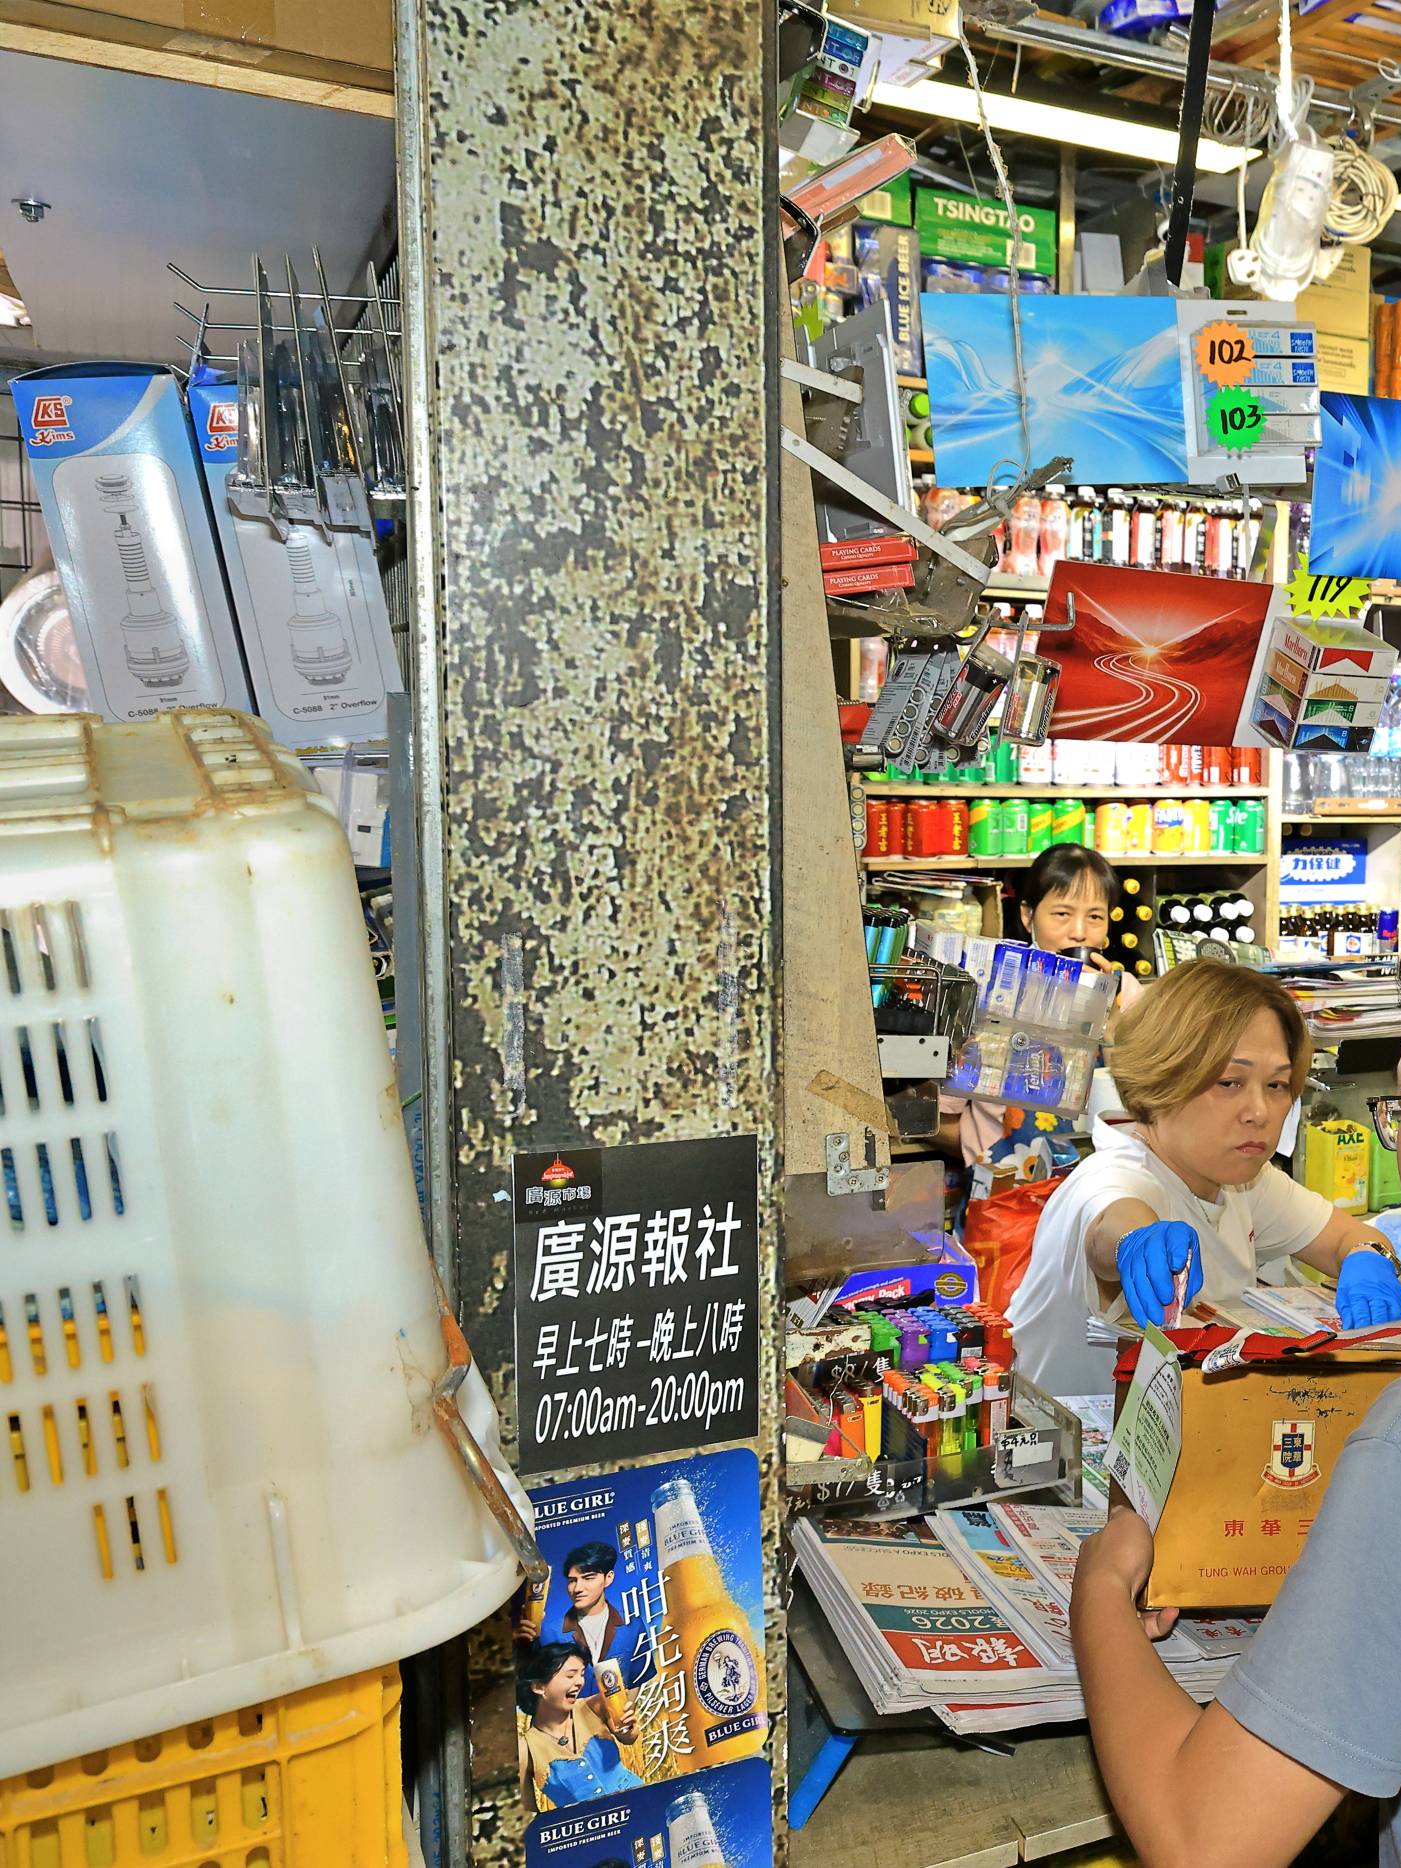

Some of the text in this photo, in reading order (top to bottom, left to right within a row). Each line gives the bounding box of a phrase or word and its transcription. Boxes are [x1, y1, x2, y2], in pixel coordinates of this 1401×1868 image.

[934, 197, 1035, 234] TSINGTAO
[897, 234, 911, 273] BEER
[898, 277, 911, 299] ICE
[897, 304, 911, 342] BLUE
[1209, 339, 1251, 365] 102
[1221, 405, 1261, 435] 103
[30, 429, 75, 446] Kims
[206, 436, 238, 451] Kim
[832, 544, 882, 557] PLAYING CARDS
[830, 573, 879, 585] PLAYING CARDS
[1308, 575, 1353, 602] 119
[1284, 632, 1308, 661] Marlboro
[293, 704, 323, 714] C-5088
[341, 698, 378, 709] Overflow
[1292, 857, 1341, 870] 力保健
[1336, 1132, 1365, 1146] AXE
[525, 1186, 592, 1207] 廣源市場
[530, 1201, 742, 1303] 廣源報社
[879, 1285, 906, 1300] Pack
[535, 1370, 745, 1444] 07:00am-20:00pm
[534, 1492, 614, 1519] LUE GIRL
[562, 1515, 590, 1526] PREMIUM
[591, 1512, 606, 1520] BEER
[1199, 1567, 1228, 1578] TUNG
[1232, 1566, 1257, 1577] WAH
[698, 1653, 709, 1681] GERMAN
[708, 1634, 735, 1653] BREWING
[621, 1570, 696, 1778] 咁先夠爽
[704, 1692, 733, 1714] PILSENER
[708, 1724, 742, 1742] BLUE
[540, 1811, 628, 1845] BLUE GIRL
[547, 1829, 621, 1854] IMPORTED PREMIUM BEER
